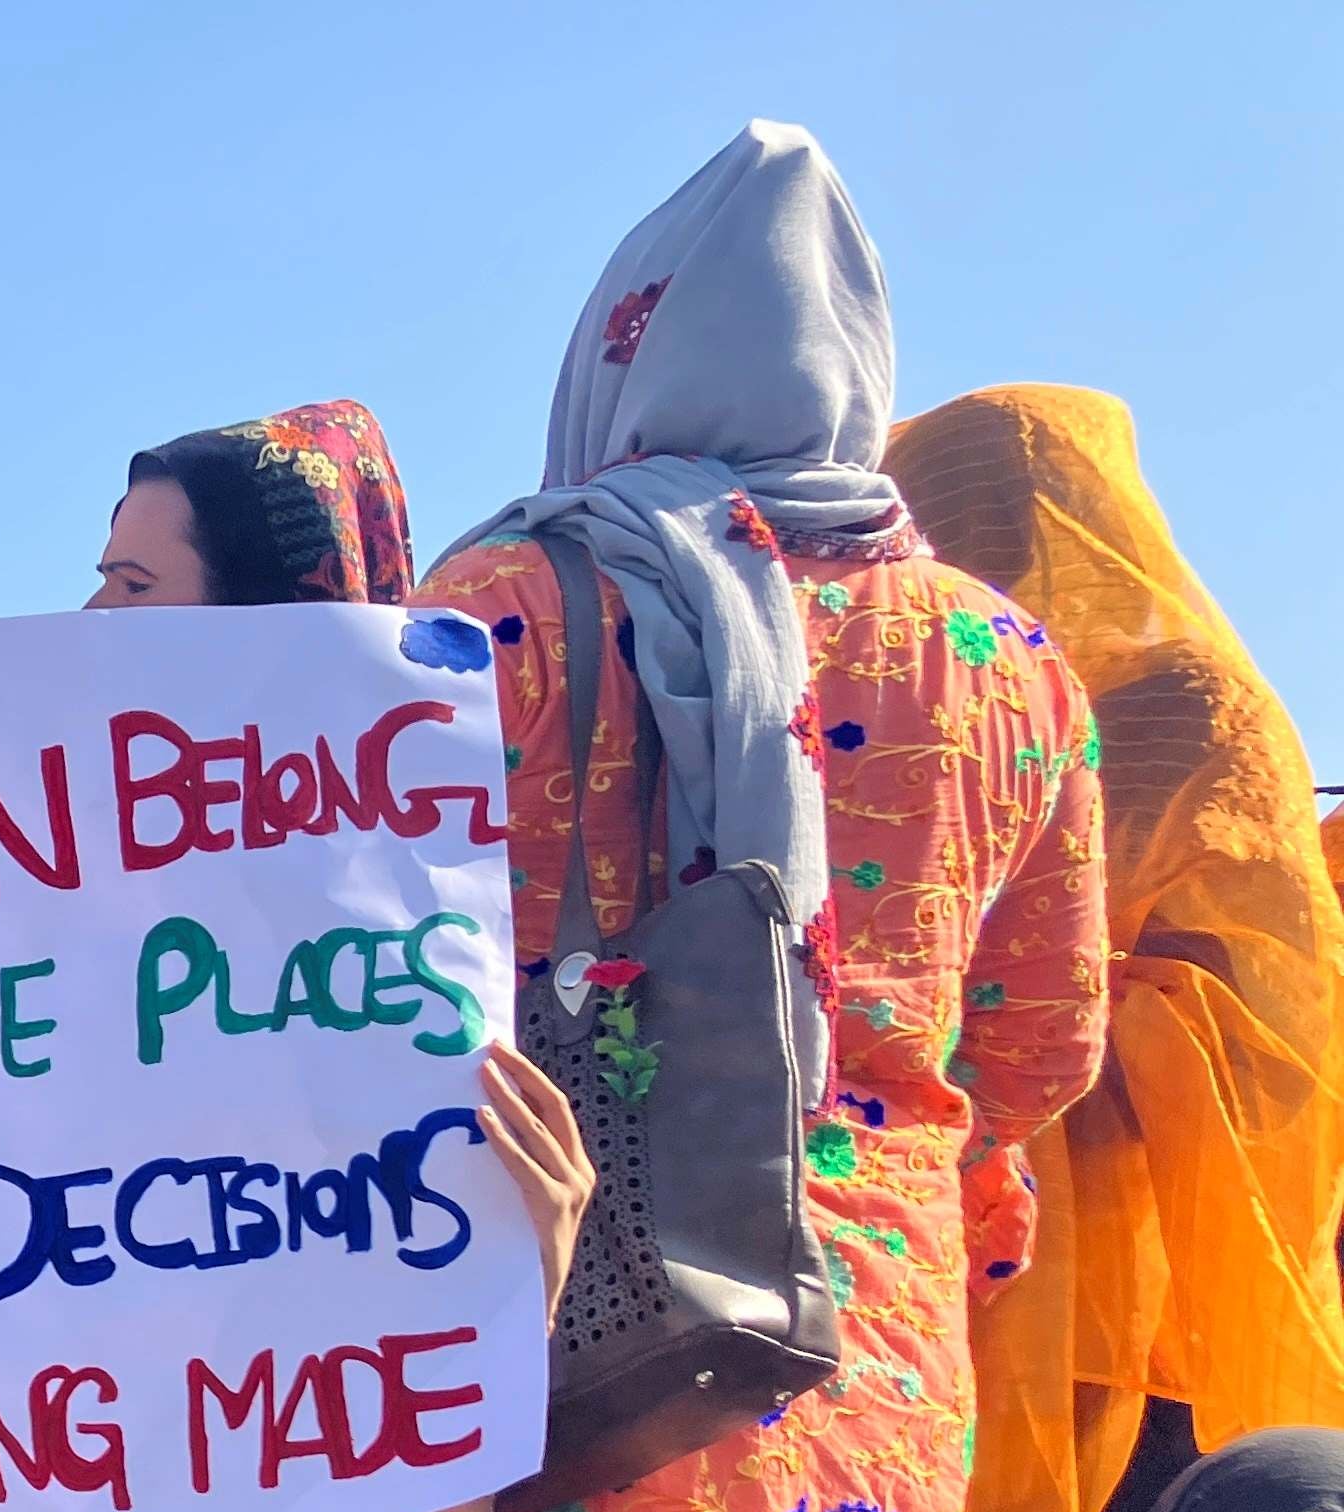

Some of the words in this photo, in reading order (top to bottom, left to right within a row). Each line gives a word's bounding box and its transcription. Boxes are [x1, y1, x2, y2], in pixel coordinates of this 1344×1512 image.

[110, 702, 509, 875] BELONG
[137, 912, 486, 1065] PLACES
[185, 1327, 484, 1496] MADE
